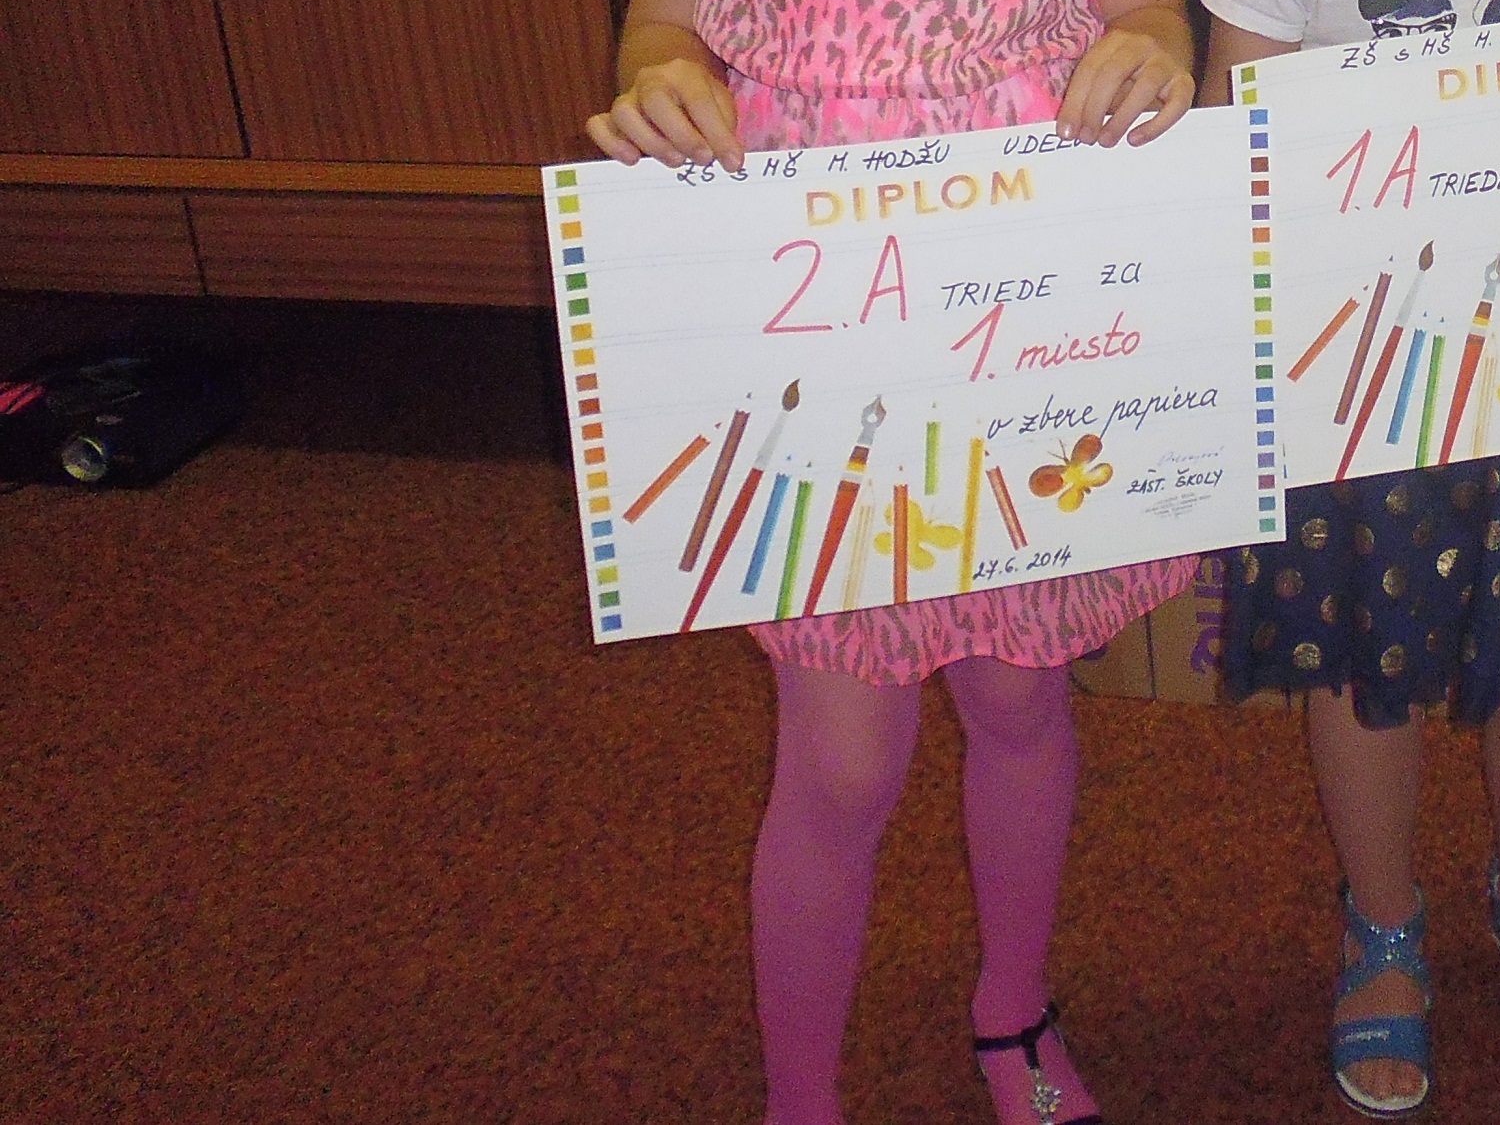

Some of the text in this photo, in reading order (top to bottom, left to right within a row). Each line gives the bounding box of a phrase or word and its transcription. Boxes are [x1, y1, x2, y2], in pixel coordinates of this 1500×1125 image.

[1341, 40, 1378, 70] ZŠ
[807, 167, 1036, 228] DIPLOM
[941, 274, 1059, 311] TRIEDE
[950, 303, 1143, 383] 1. miesto
[1018, 394, 1097, 435] zbere
[1100, 386, 1219, 438] papiera
[1175, 468, 1223, 488] ŠKOLY
